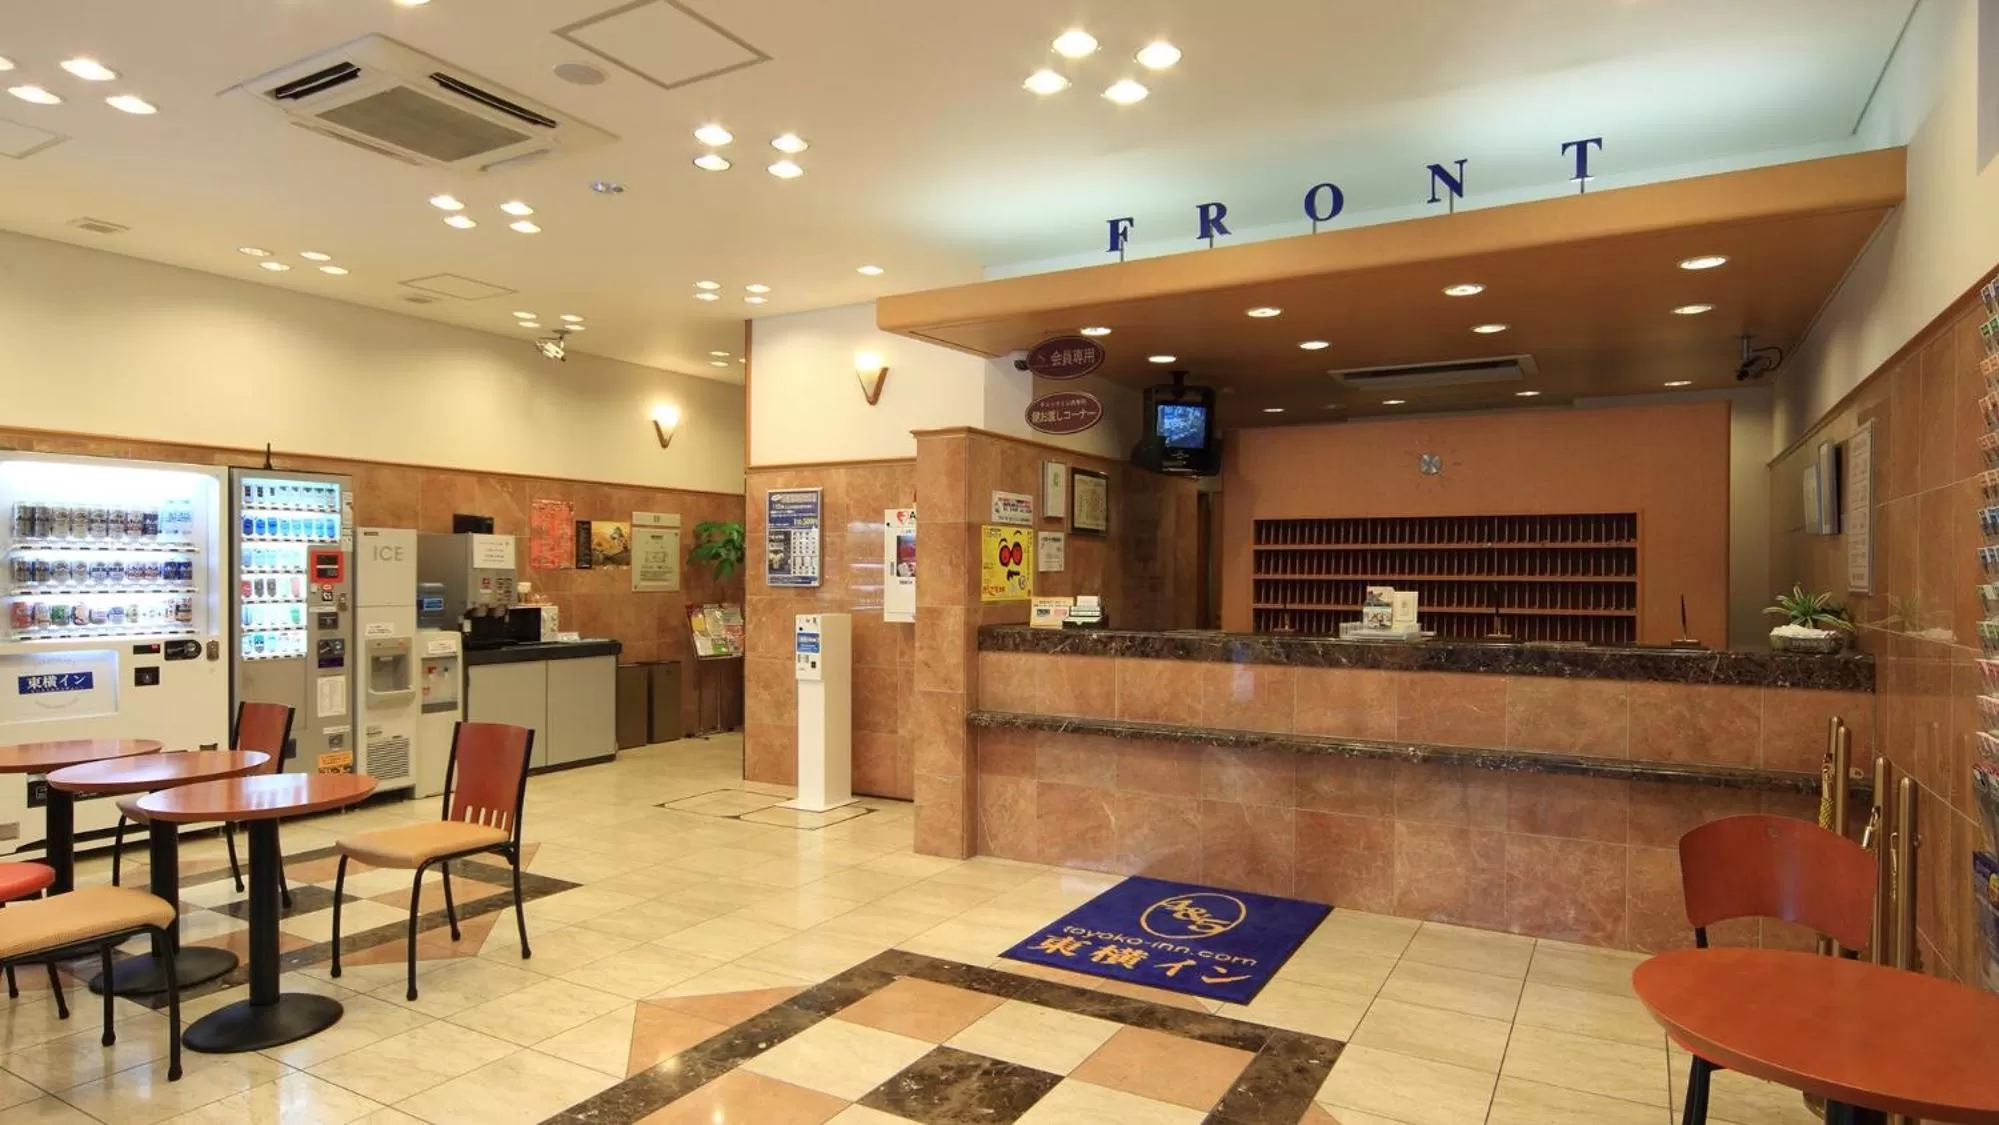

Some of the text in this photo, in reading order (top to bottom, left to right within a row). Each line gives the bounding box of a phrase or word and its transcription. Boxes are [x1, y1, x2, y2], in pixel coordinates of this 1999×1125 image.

[1106, 137, 1603, 253] FRONT
[373, 545, 404, 561] ICE
[27, 674, 86, 690] 東横イン
[1028, 935, 1253, 983] 東横イン
[1063, 925, 1257, 967] toyoko-inn.com
